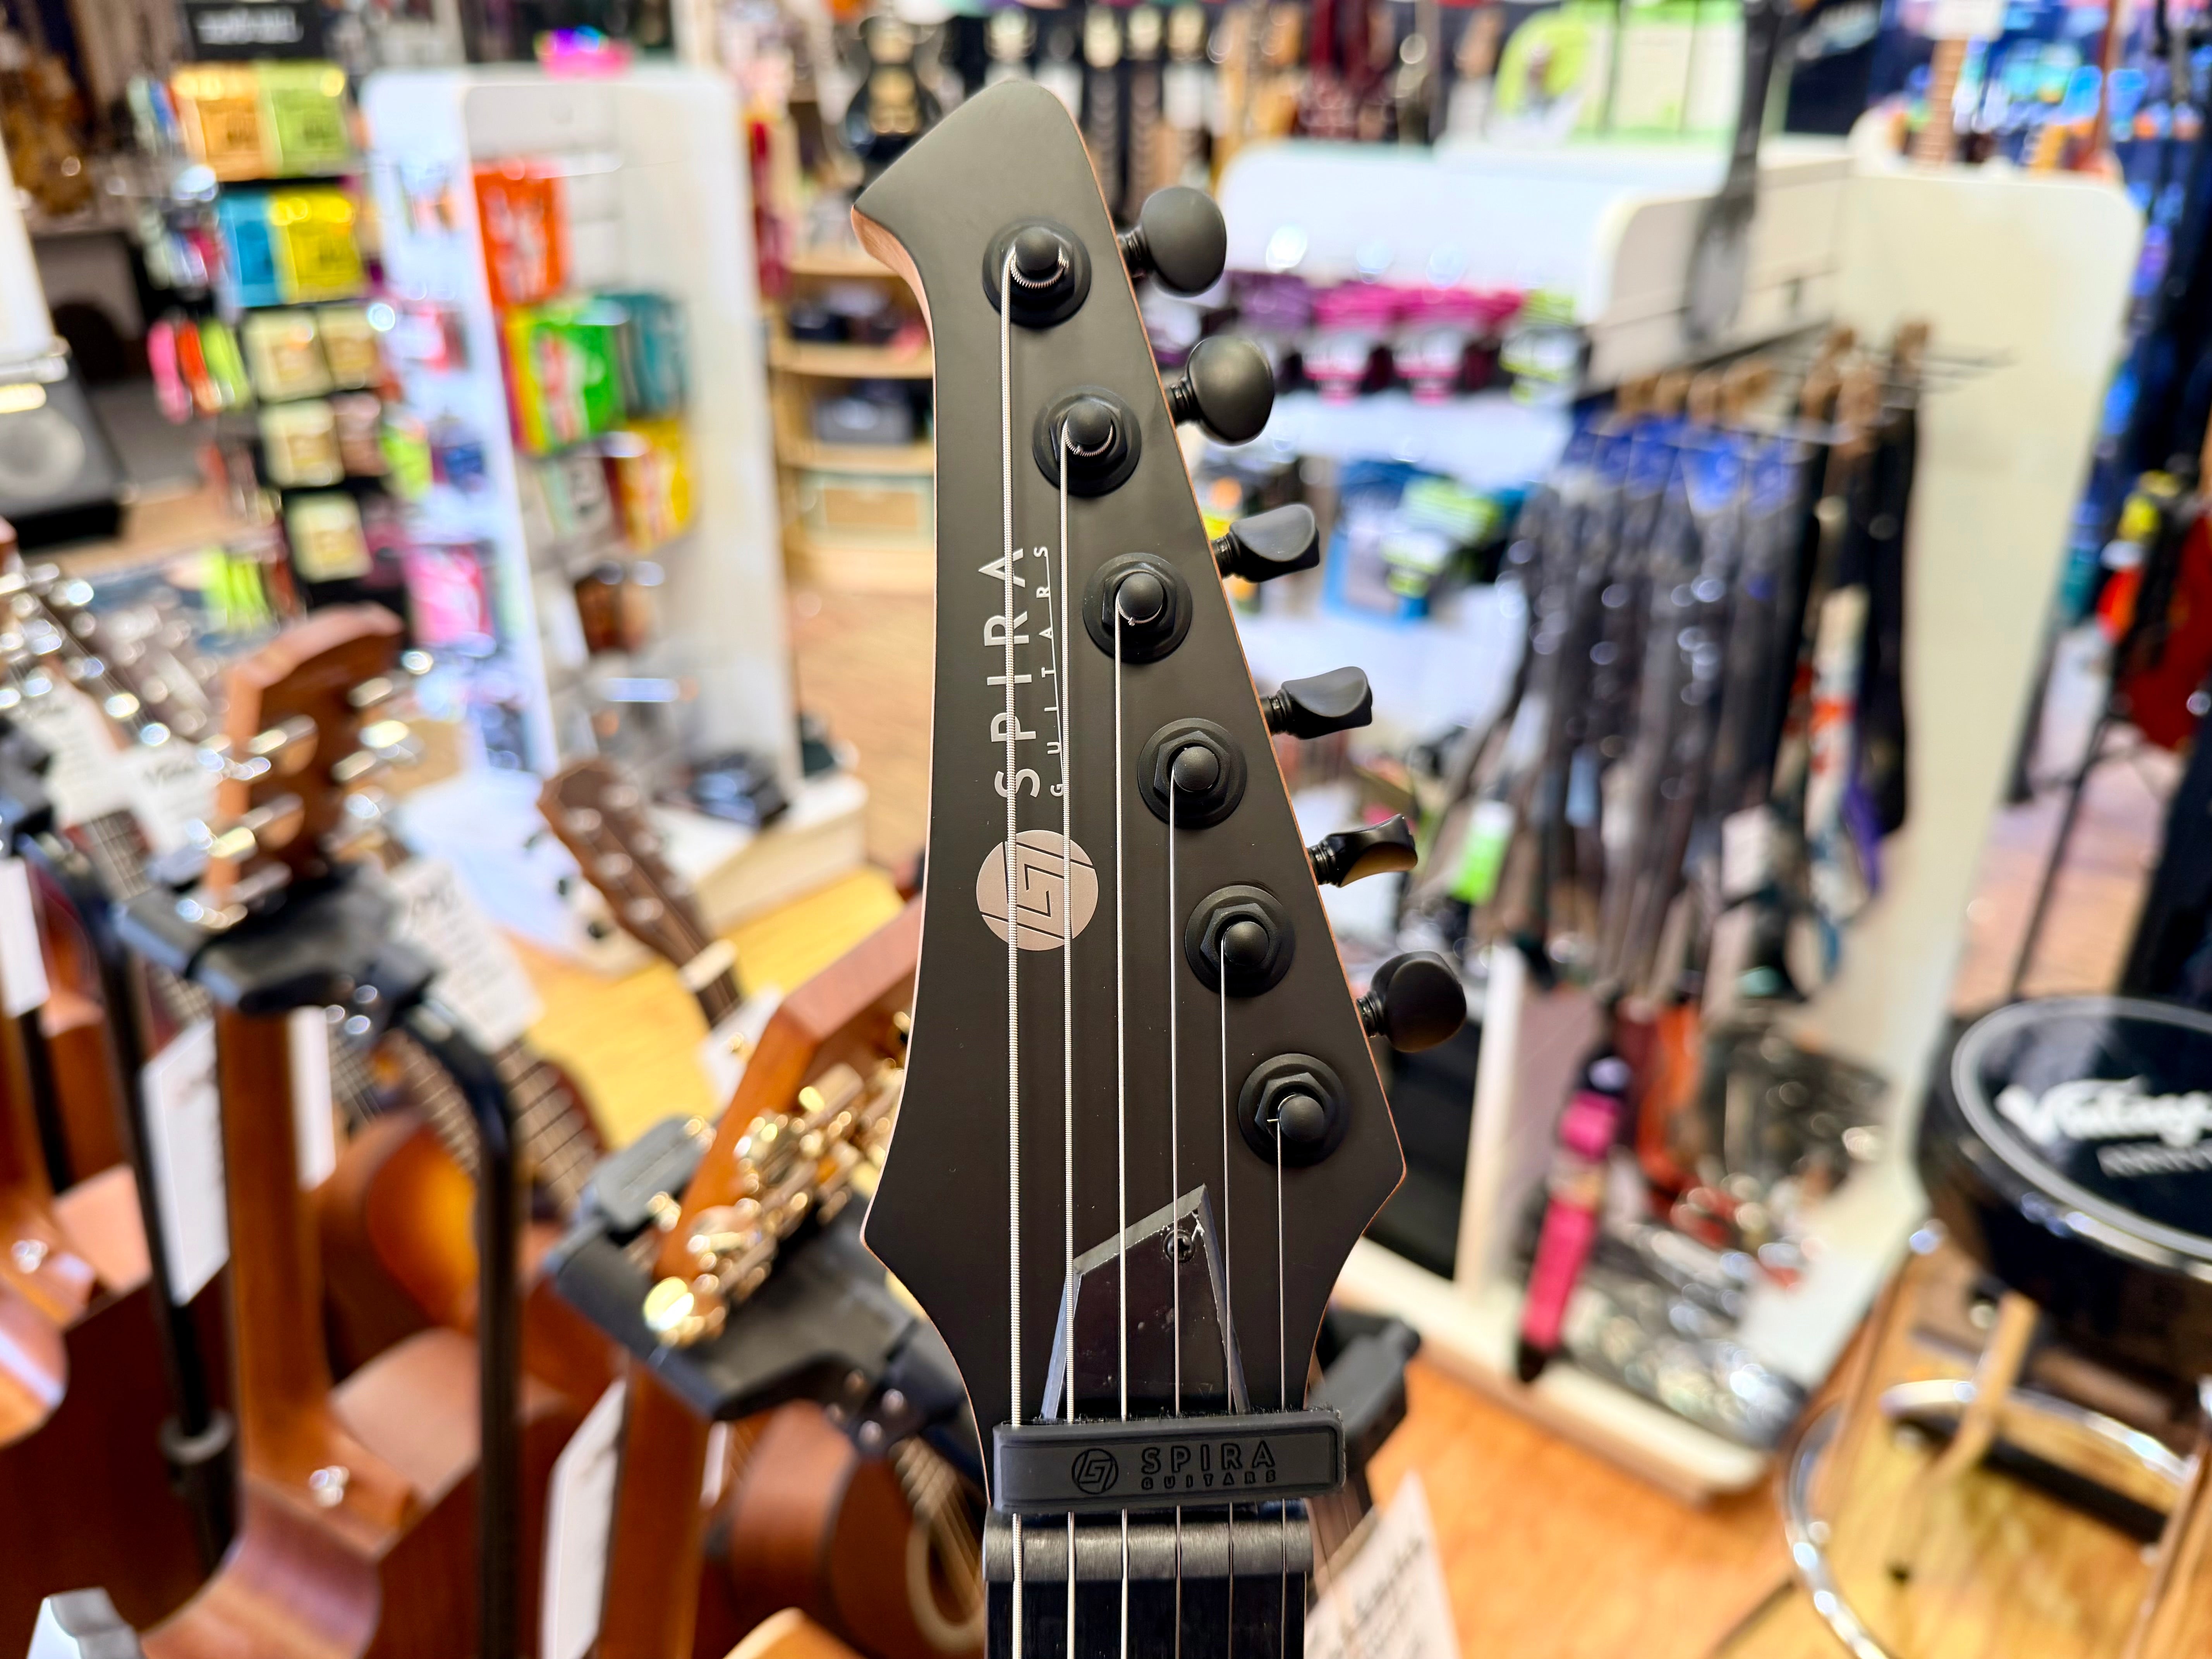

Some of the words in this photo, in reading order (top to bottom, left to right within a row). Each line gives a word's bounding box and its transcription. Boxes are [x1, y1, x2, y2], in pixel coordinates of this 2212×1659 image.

[978, 548, 1041, 798] SPIRA
[1034, 546, 1064, 797] GUITARS
[1141, 1440, 1276, 1475] SPIRA
[1141, 1470, 1277, 1490] GUITARS
